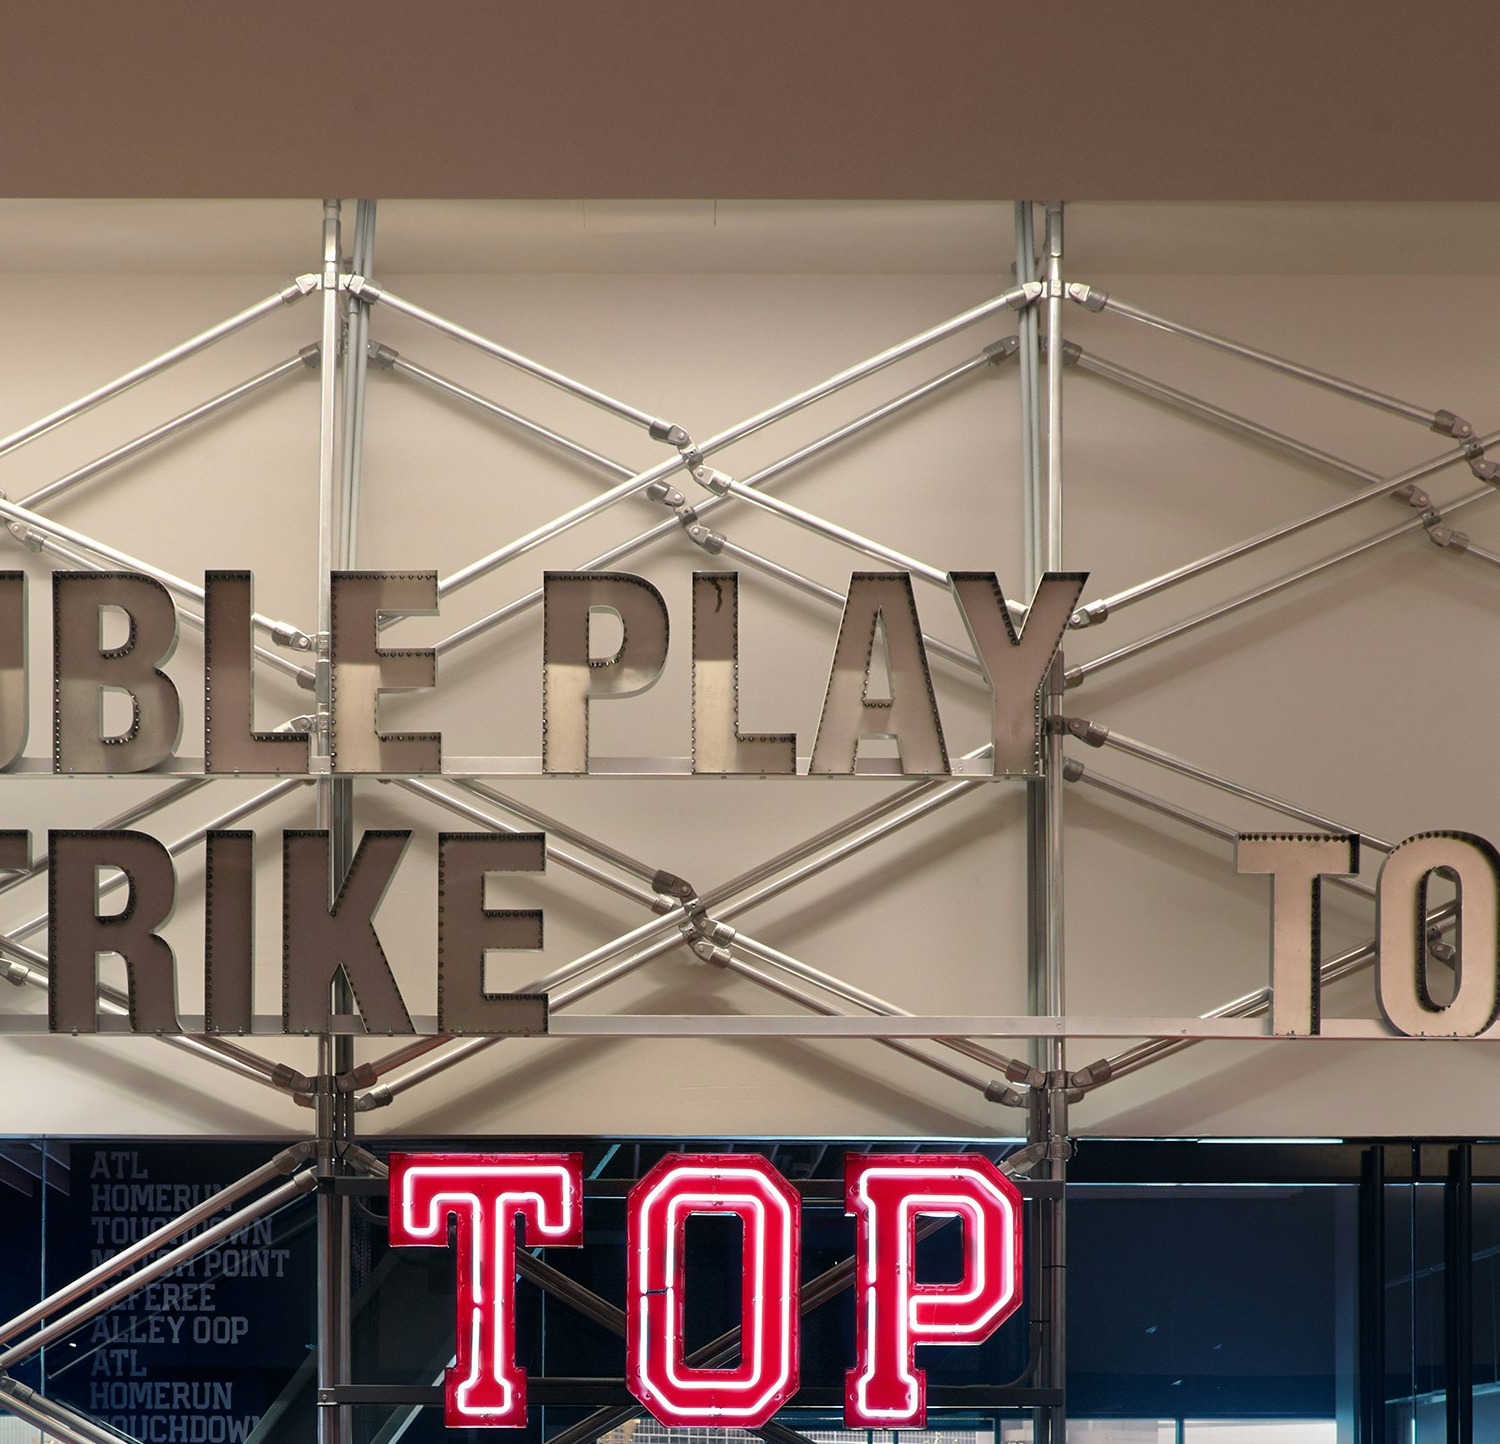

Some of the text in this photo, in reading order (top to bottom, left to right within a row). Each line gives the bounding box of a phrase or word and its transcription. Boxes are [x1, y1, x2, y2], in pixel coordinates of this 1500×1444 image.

[543, 570, 1090, 775] PLAY
[90, 1151, 148, 1179] ATL
[204, 1249, 290, 1278] POINT
[387, 1151, 1024, 1430] TOP
[90, 1316, 249, 1344] ALLEY OOP
[90, 1349, 147, 1377] ATL
[90, 1381, 233, 1410] HOMERUN
[91, 1414, 262, 1443] OUCHDOW
